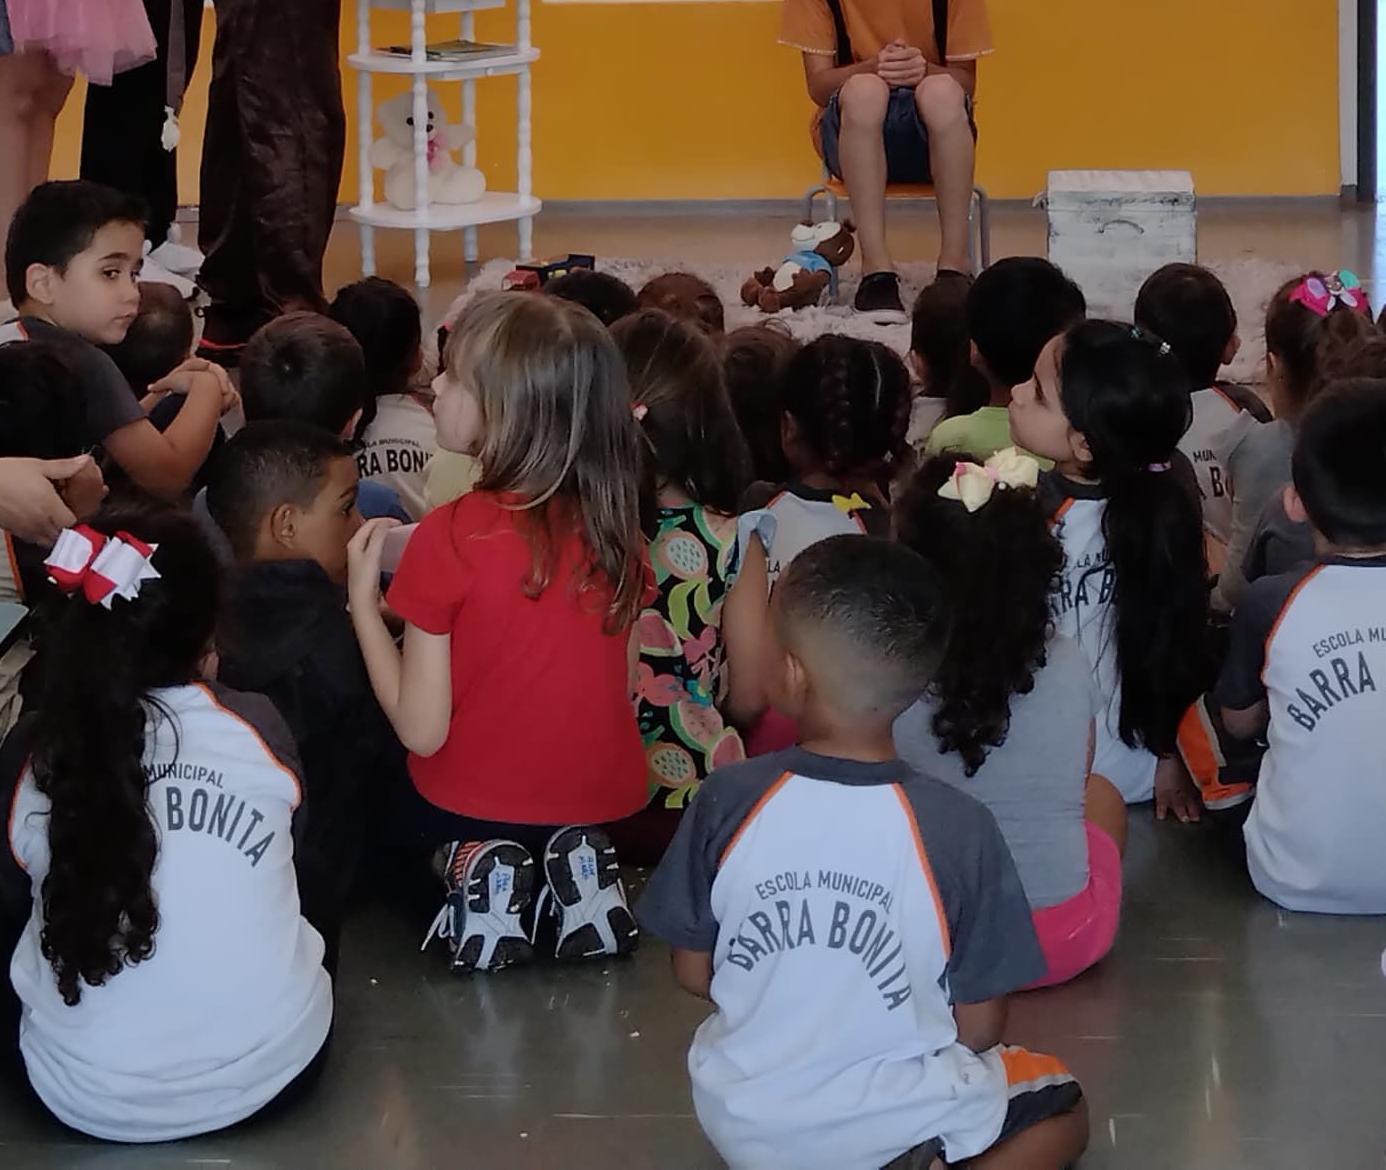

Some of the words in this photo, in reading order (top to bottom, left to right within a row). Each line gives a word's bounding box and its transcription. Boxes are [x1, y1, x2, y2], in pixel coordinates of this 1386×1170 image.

[1312, 629, 1365, 659] ESCOLA
[1286, 650, 1376, 732] BARRA
[144, 762, 224, 789] MUNICIPAL
[166, 786, 275, 868] BONITA
[755, 871, 812, 900] ESCOLA
[817, 869, 894, 915] MUNICIPAL
